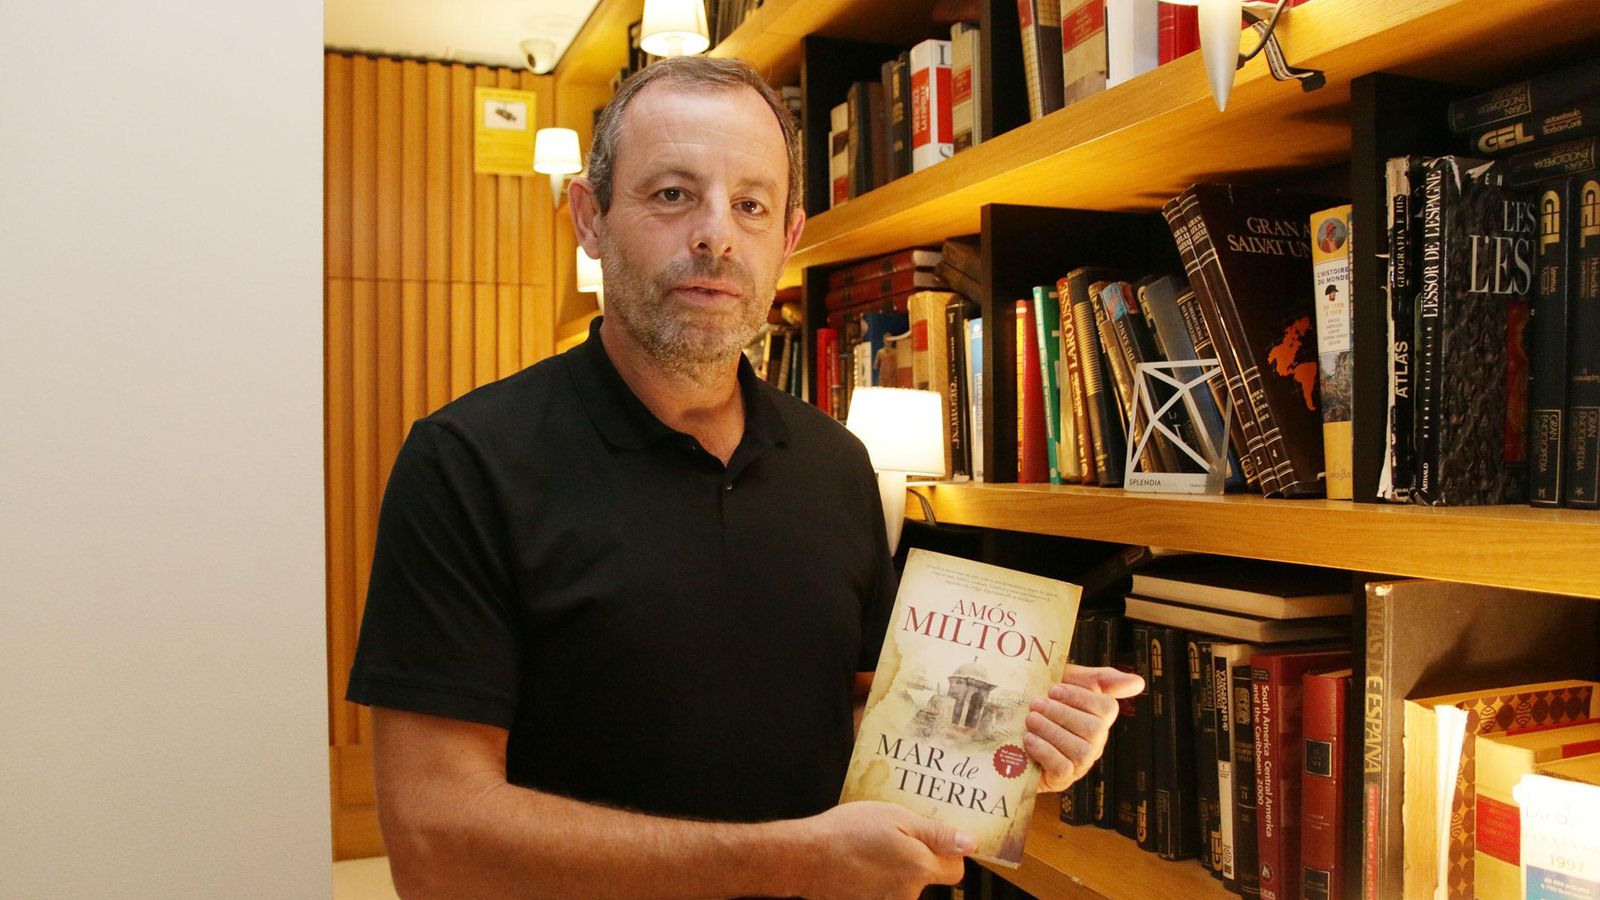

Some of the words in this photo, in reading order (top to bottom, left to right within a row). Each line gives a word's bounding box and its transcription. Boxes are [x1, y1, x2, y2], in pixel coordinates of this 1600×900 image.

[1477, 122, 1535, 153] GEL
[1424, 170, 1442, 237] L'ESPAGNE
[1541, 190, 1560, 255] GEL
[1580, 180, 1600, 248] GEL
[1227, 234, 1284, 256] SALVAT
[1247, 217, 1299, 237] GRAN
[1424, 242, 1440, 260] DE
[1326, 273, 1350, 283] MONDE
[1423, 265, 1439, 318] L'ESSOR
[1057, 281, 1078, 366] LAROUSSE
[1395, 341, 1409, 398] ATLAS
[1128, 478, 1162, 487] SPLENDIA
[951, 599, 1018, 628] AMÓS
[902, 606, 1057, 666] MILTON
[1151, 639, 1163, 682] GEL
[1367, 659, 1384, 691] DE
[1261, 685, 1270, 714] South
[876, 733, 945, 772] MAR
[952, 757, 979, 780] de
[1255, 724, 1263, 775] Caribbean
[1262, 715, 1270, 756] America
[895, 766, 1010, 818] TIERRA
[1137, 800, 1147, 843] GEL
[1550, 855, 1585, 873] 1997
